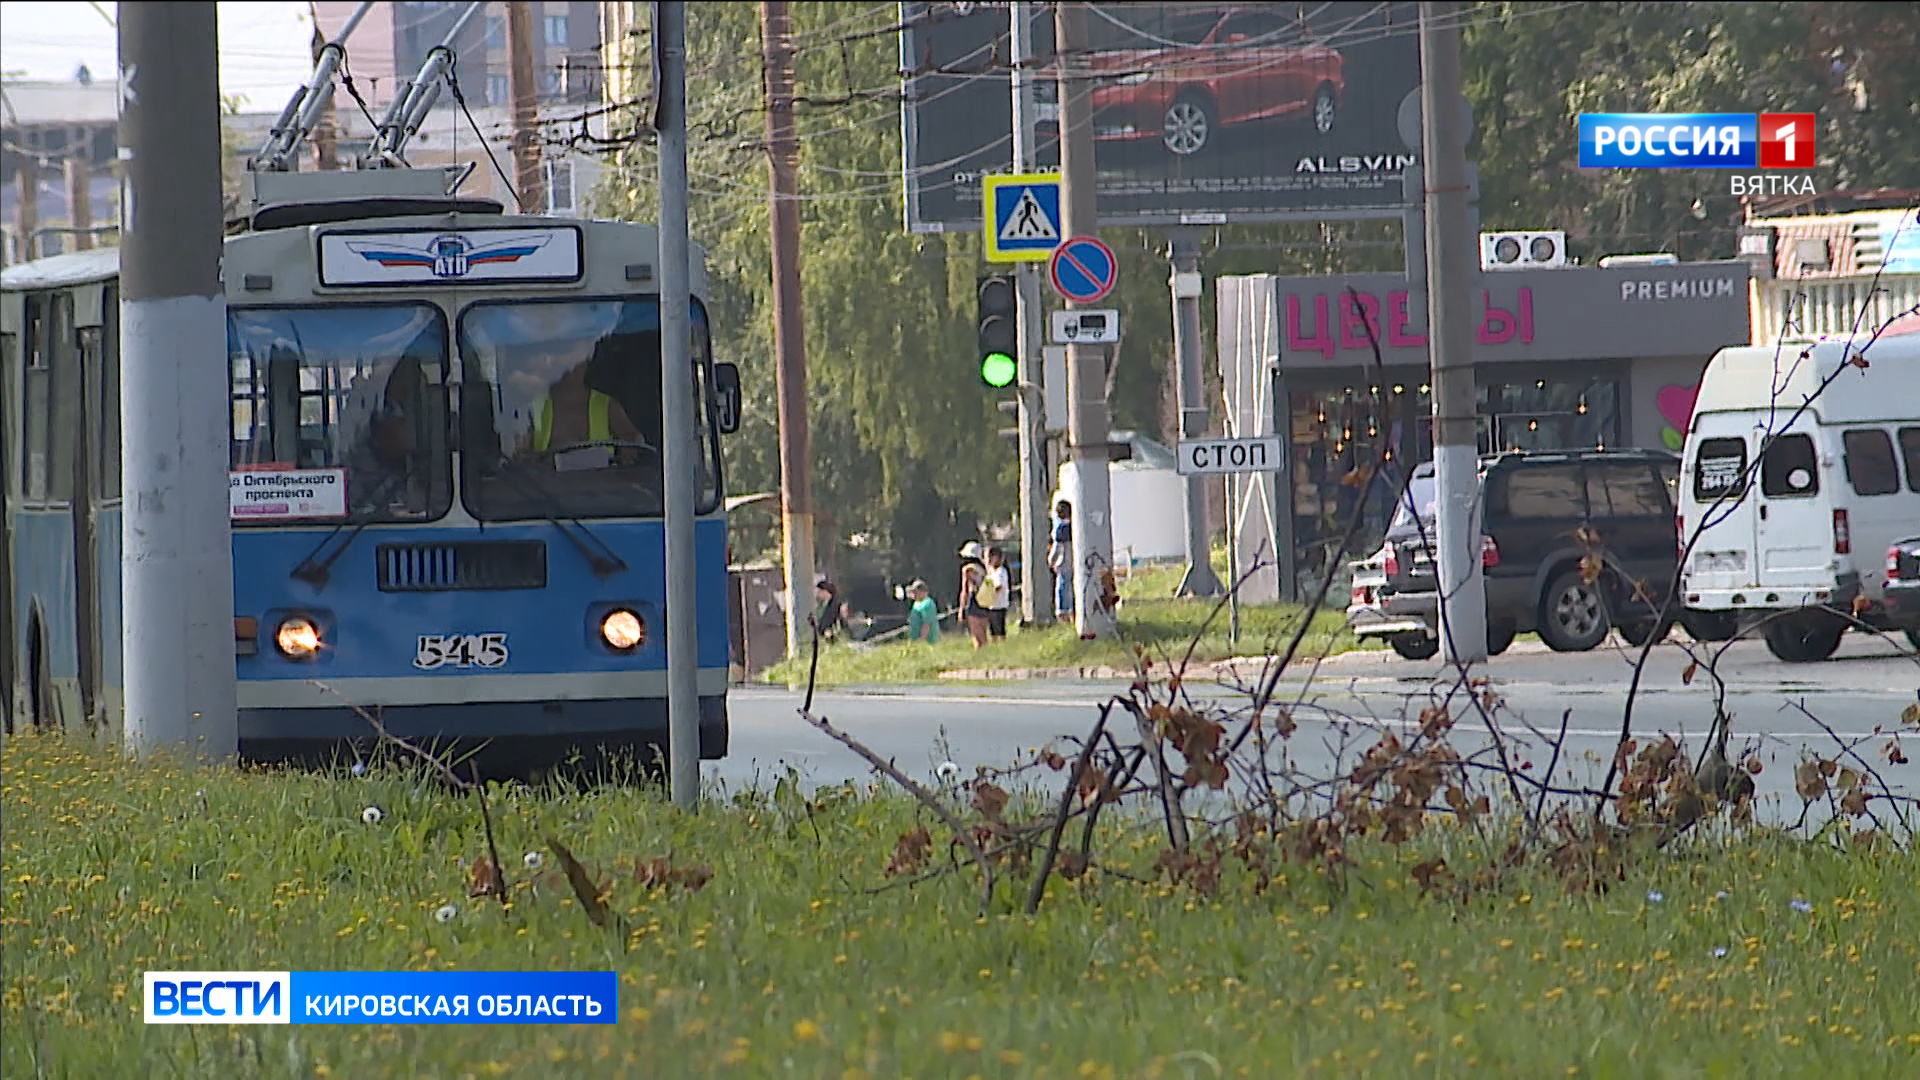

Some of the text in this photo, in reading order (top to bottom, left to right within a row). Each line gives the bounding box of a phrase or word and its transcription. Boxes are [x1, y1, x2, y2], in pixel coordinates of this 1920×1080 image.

[1296, 154, 1415, 172] ALSVIN
[434, 254, 468, 275] АТП
[1621, 279, 1736, 301] PREMIUM
[1286, 287, 1534, 358] ЦВЕЫ
[1192, 443, 1266, 468] СТОП
[243, 474, 335, 487] Октябрьского
[245, 488, 314, 501] проспекта
[413, 633, 508, 670] 545
